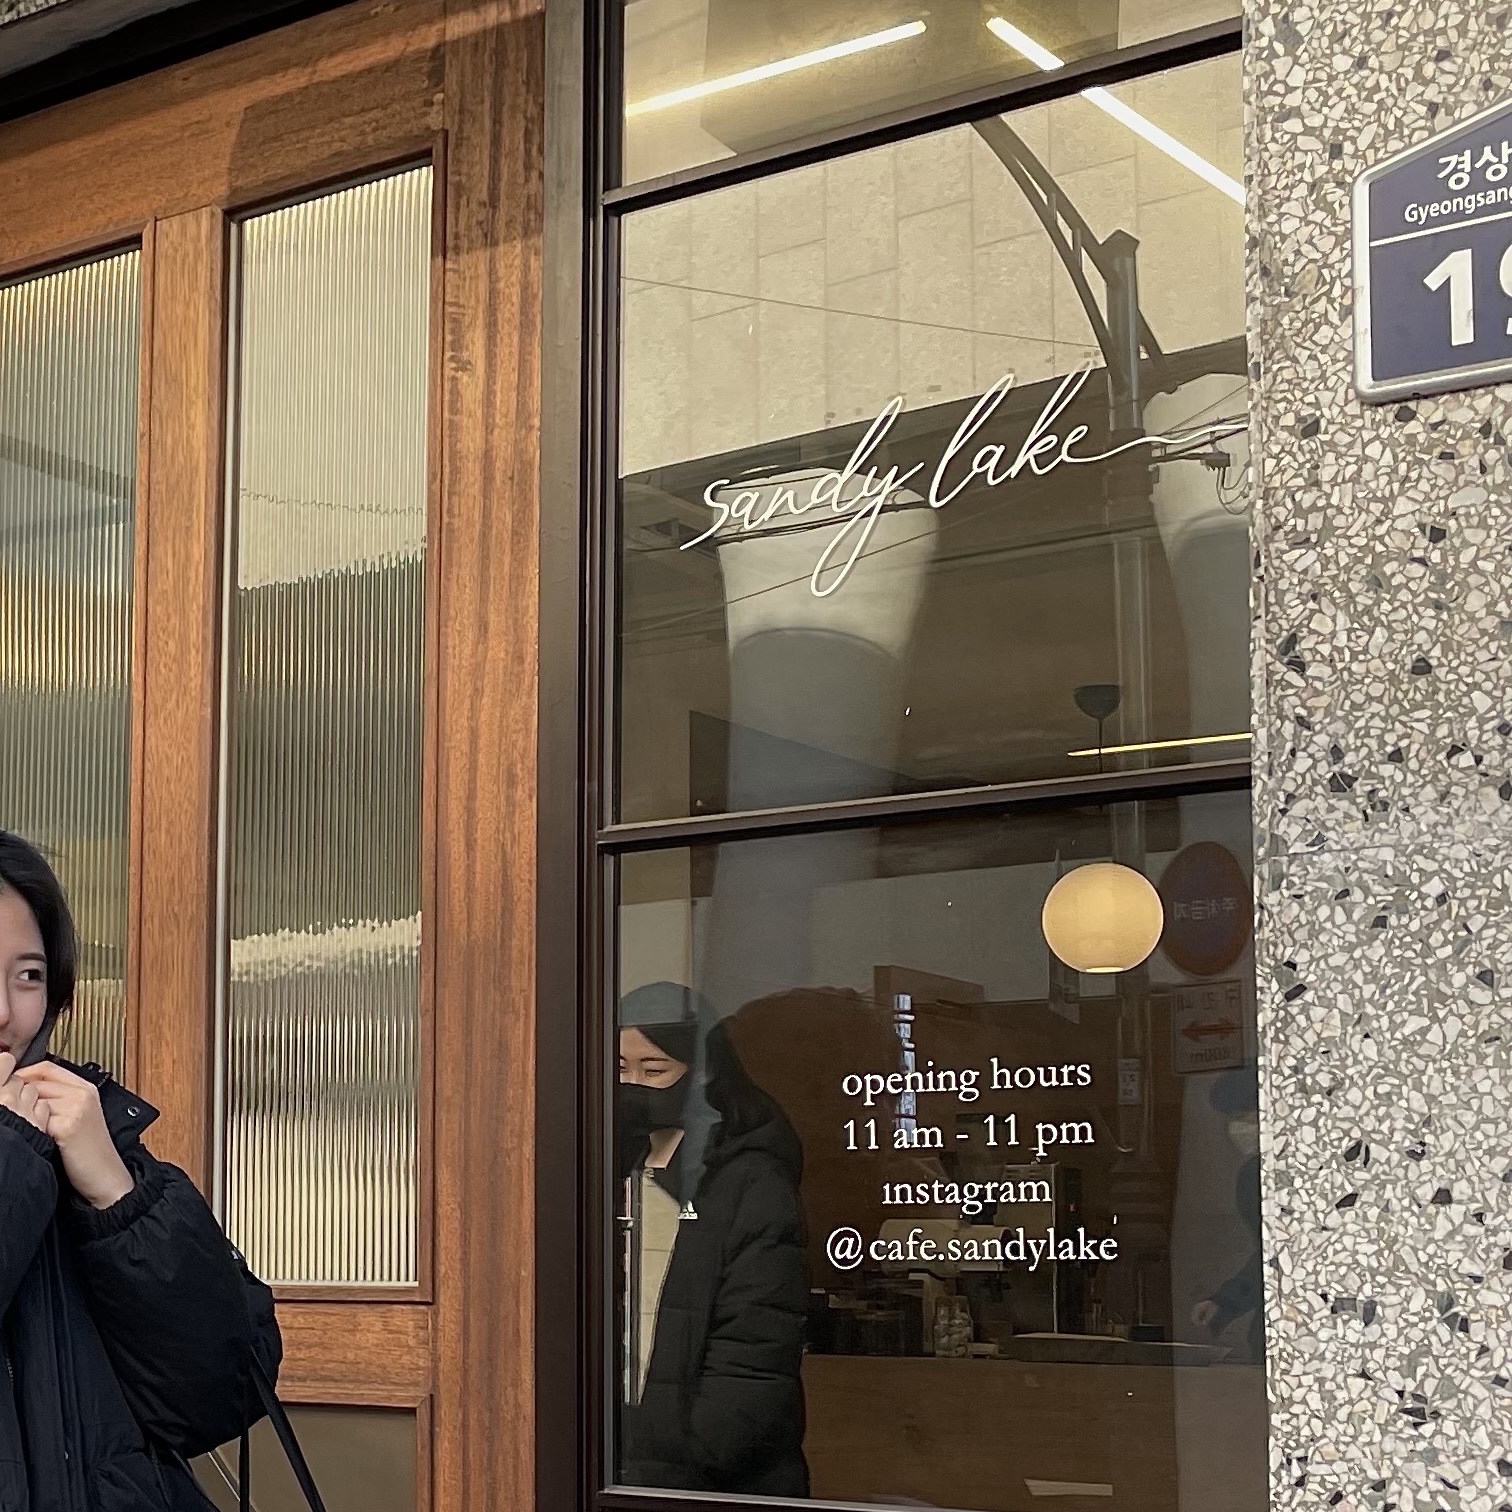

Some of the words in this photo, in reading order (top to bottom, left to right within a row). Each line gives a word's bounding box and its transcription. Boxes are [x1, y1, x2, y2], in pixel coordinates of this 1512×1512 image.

[1437, 140, 1512, 190] 경상
[1423, 242, 1512, 346] 1
[680, 395, 925, 598] sandy
[927, 358, 1249, 510] lake
[842, 1061, 980, 1106] opening
[990, 1057, 1092, 1089] hours
[843, 1118, 879, 1150] 11
[893, 1125, 944, 1149] am
[983, 1113, 1020, 1146] 11
[1035, 1120, 1095, 1157] pm
[881, 1179, 1053, 1215] instagram
[826, 1227, 1119, 1272] @cafe.sandylake
